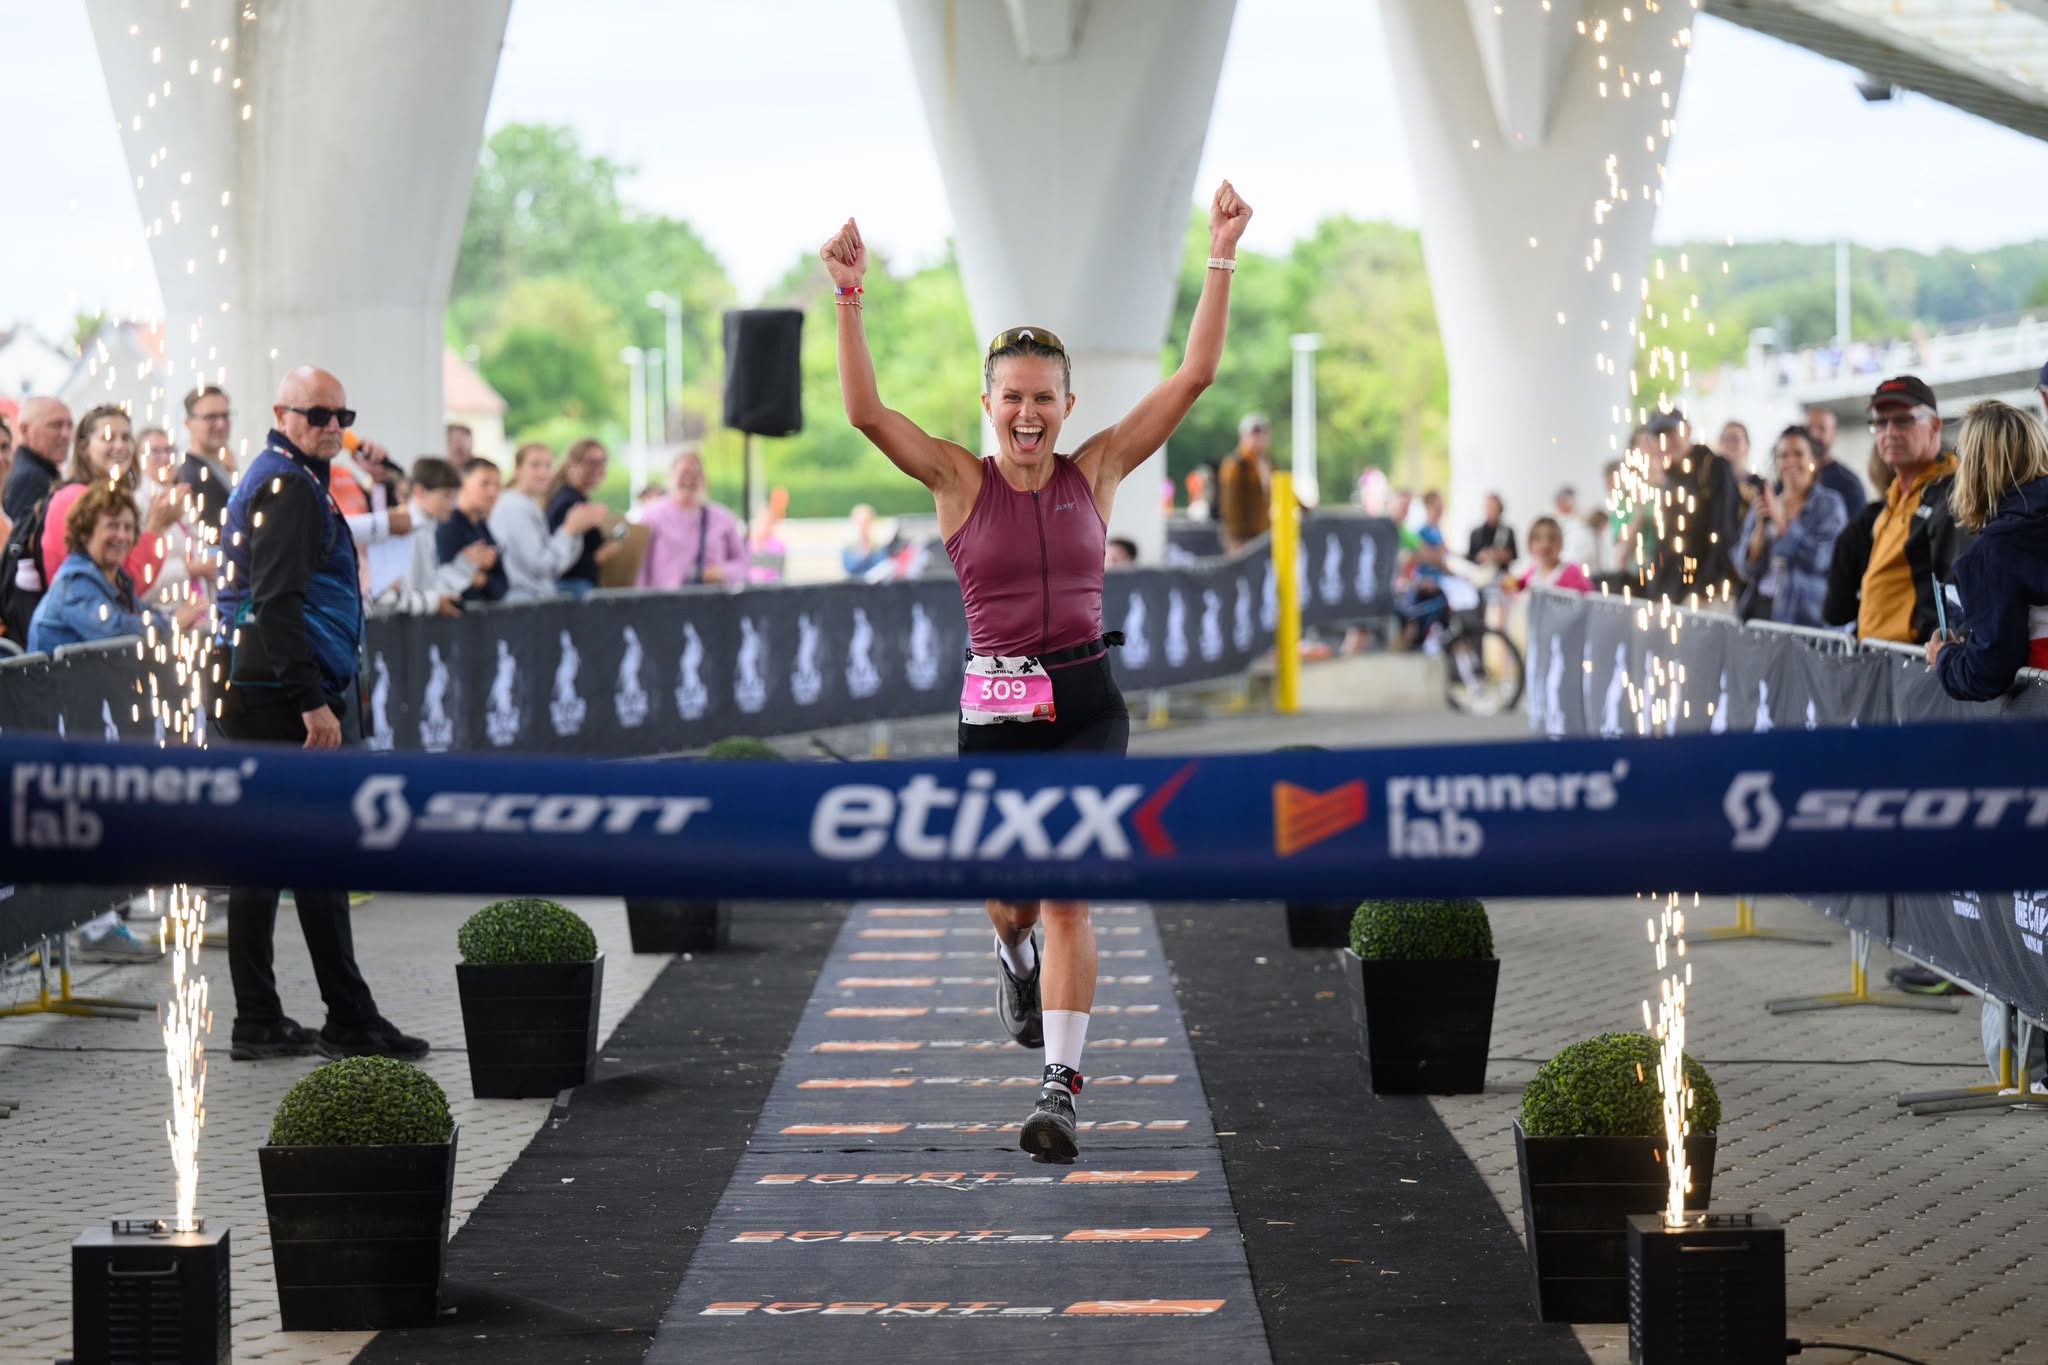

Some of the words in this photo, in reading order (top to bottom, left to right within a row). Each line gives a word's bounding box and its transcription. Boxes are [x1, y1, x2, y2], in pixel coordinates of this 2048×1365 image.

[981, 680, 1027, 700] 509
[11, 802, 103, 849] lab
[416, 793, 709, 834] SCOTT
[809, 768, 1143, 860] etixx
[1388, 811, 1483, 858] lab
